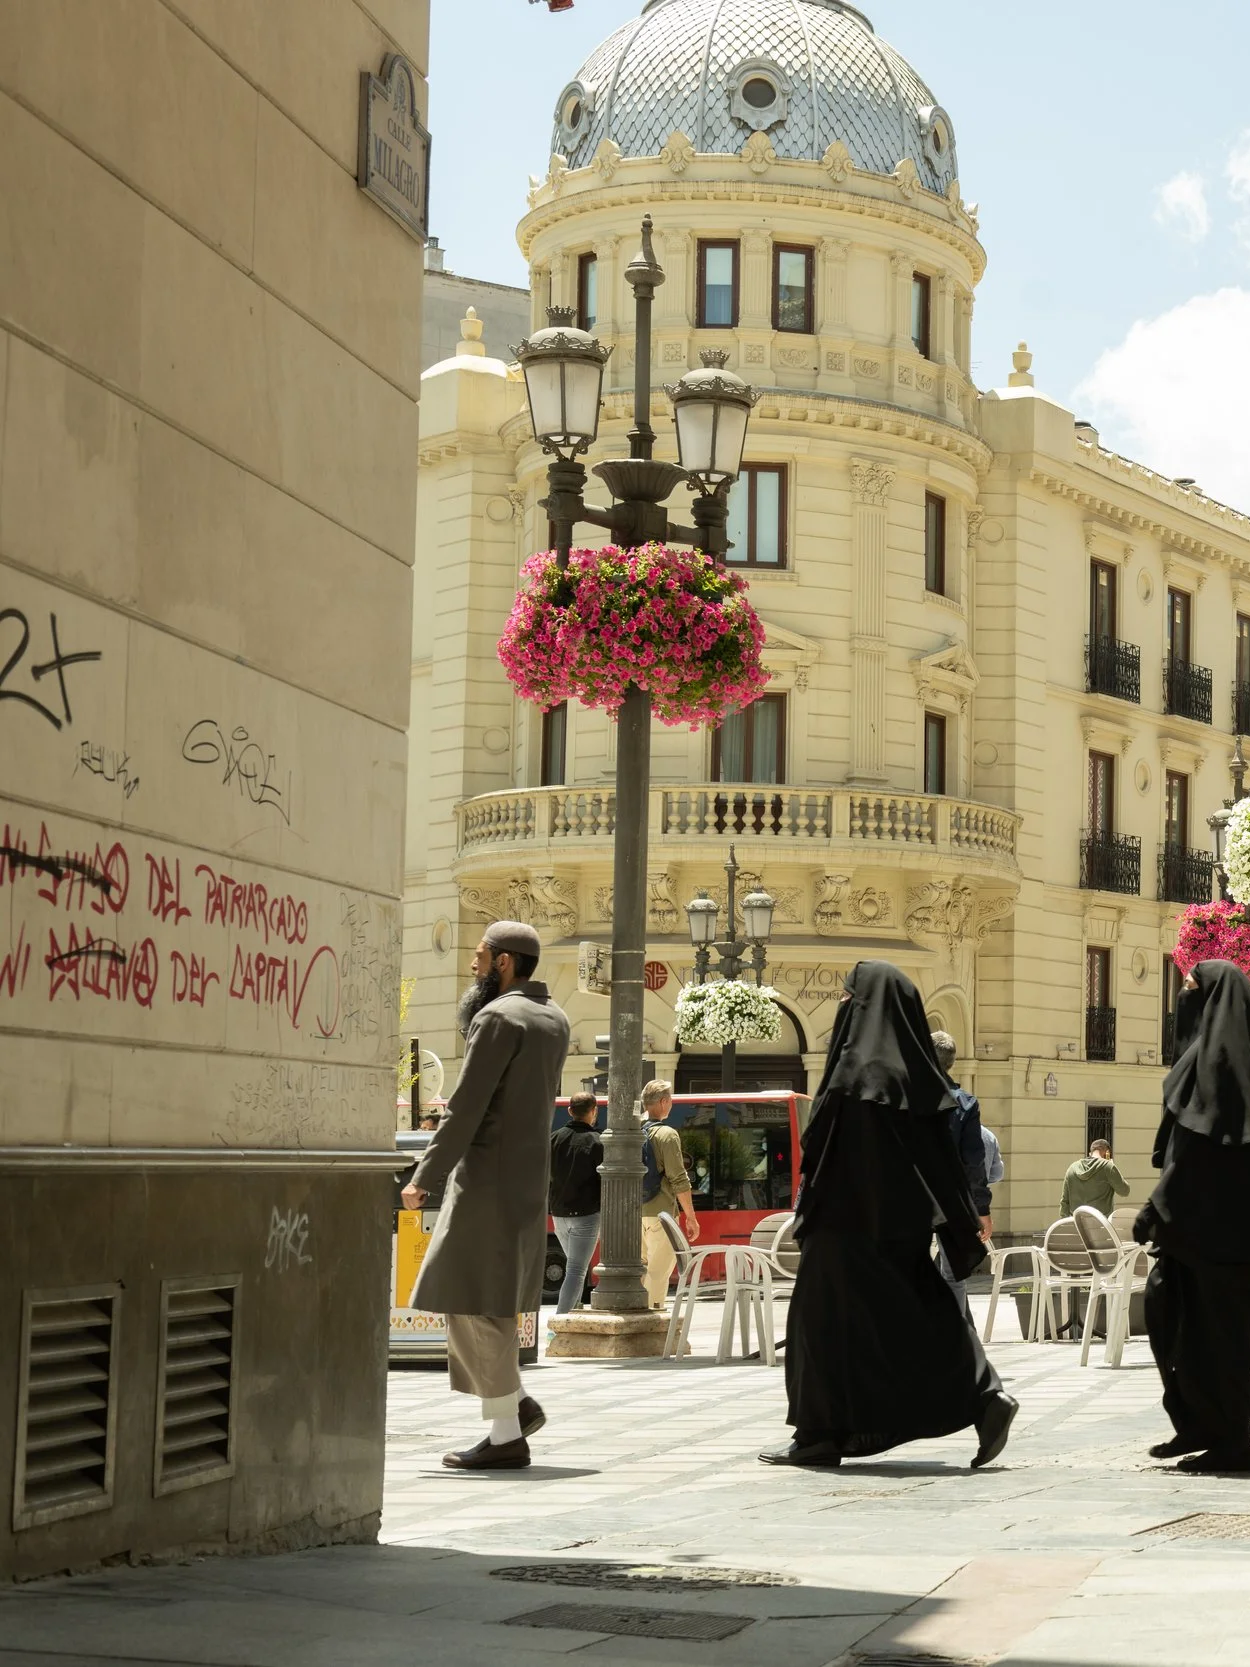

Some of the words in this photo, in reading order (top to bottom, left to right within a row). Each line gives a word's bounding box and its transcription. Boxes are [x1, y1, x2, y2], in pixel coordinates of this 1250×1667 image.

[373, 133, 420, 208] MILAGRO
[387, 117, 412, 153] CALLE
[145, 852, 192, 926] DEL
[195, 863, 309, 945] PATRIARCADO
